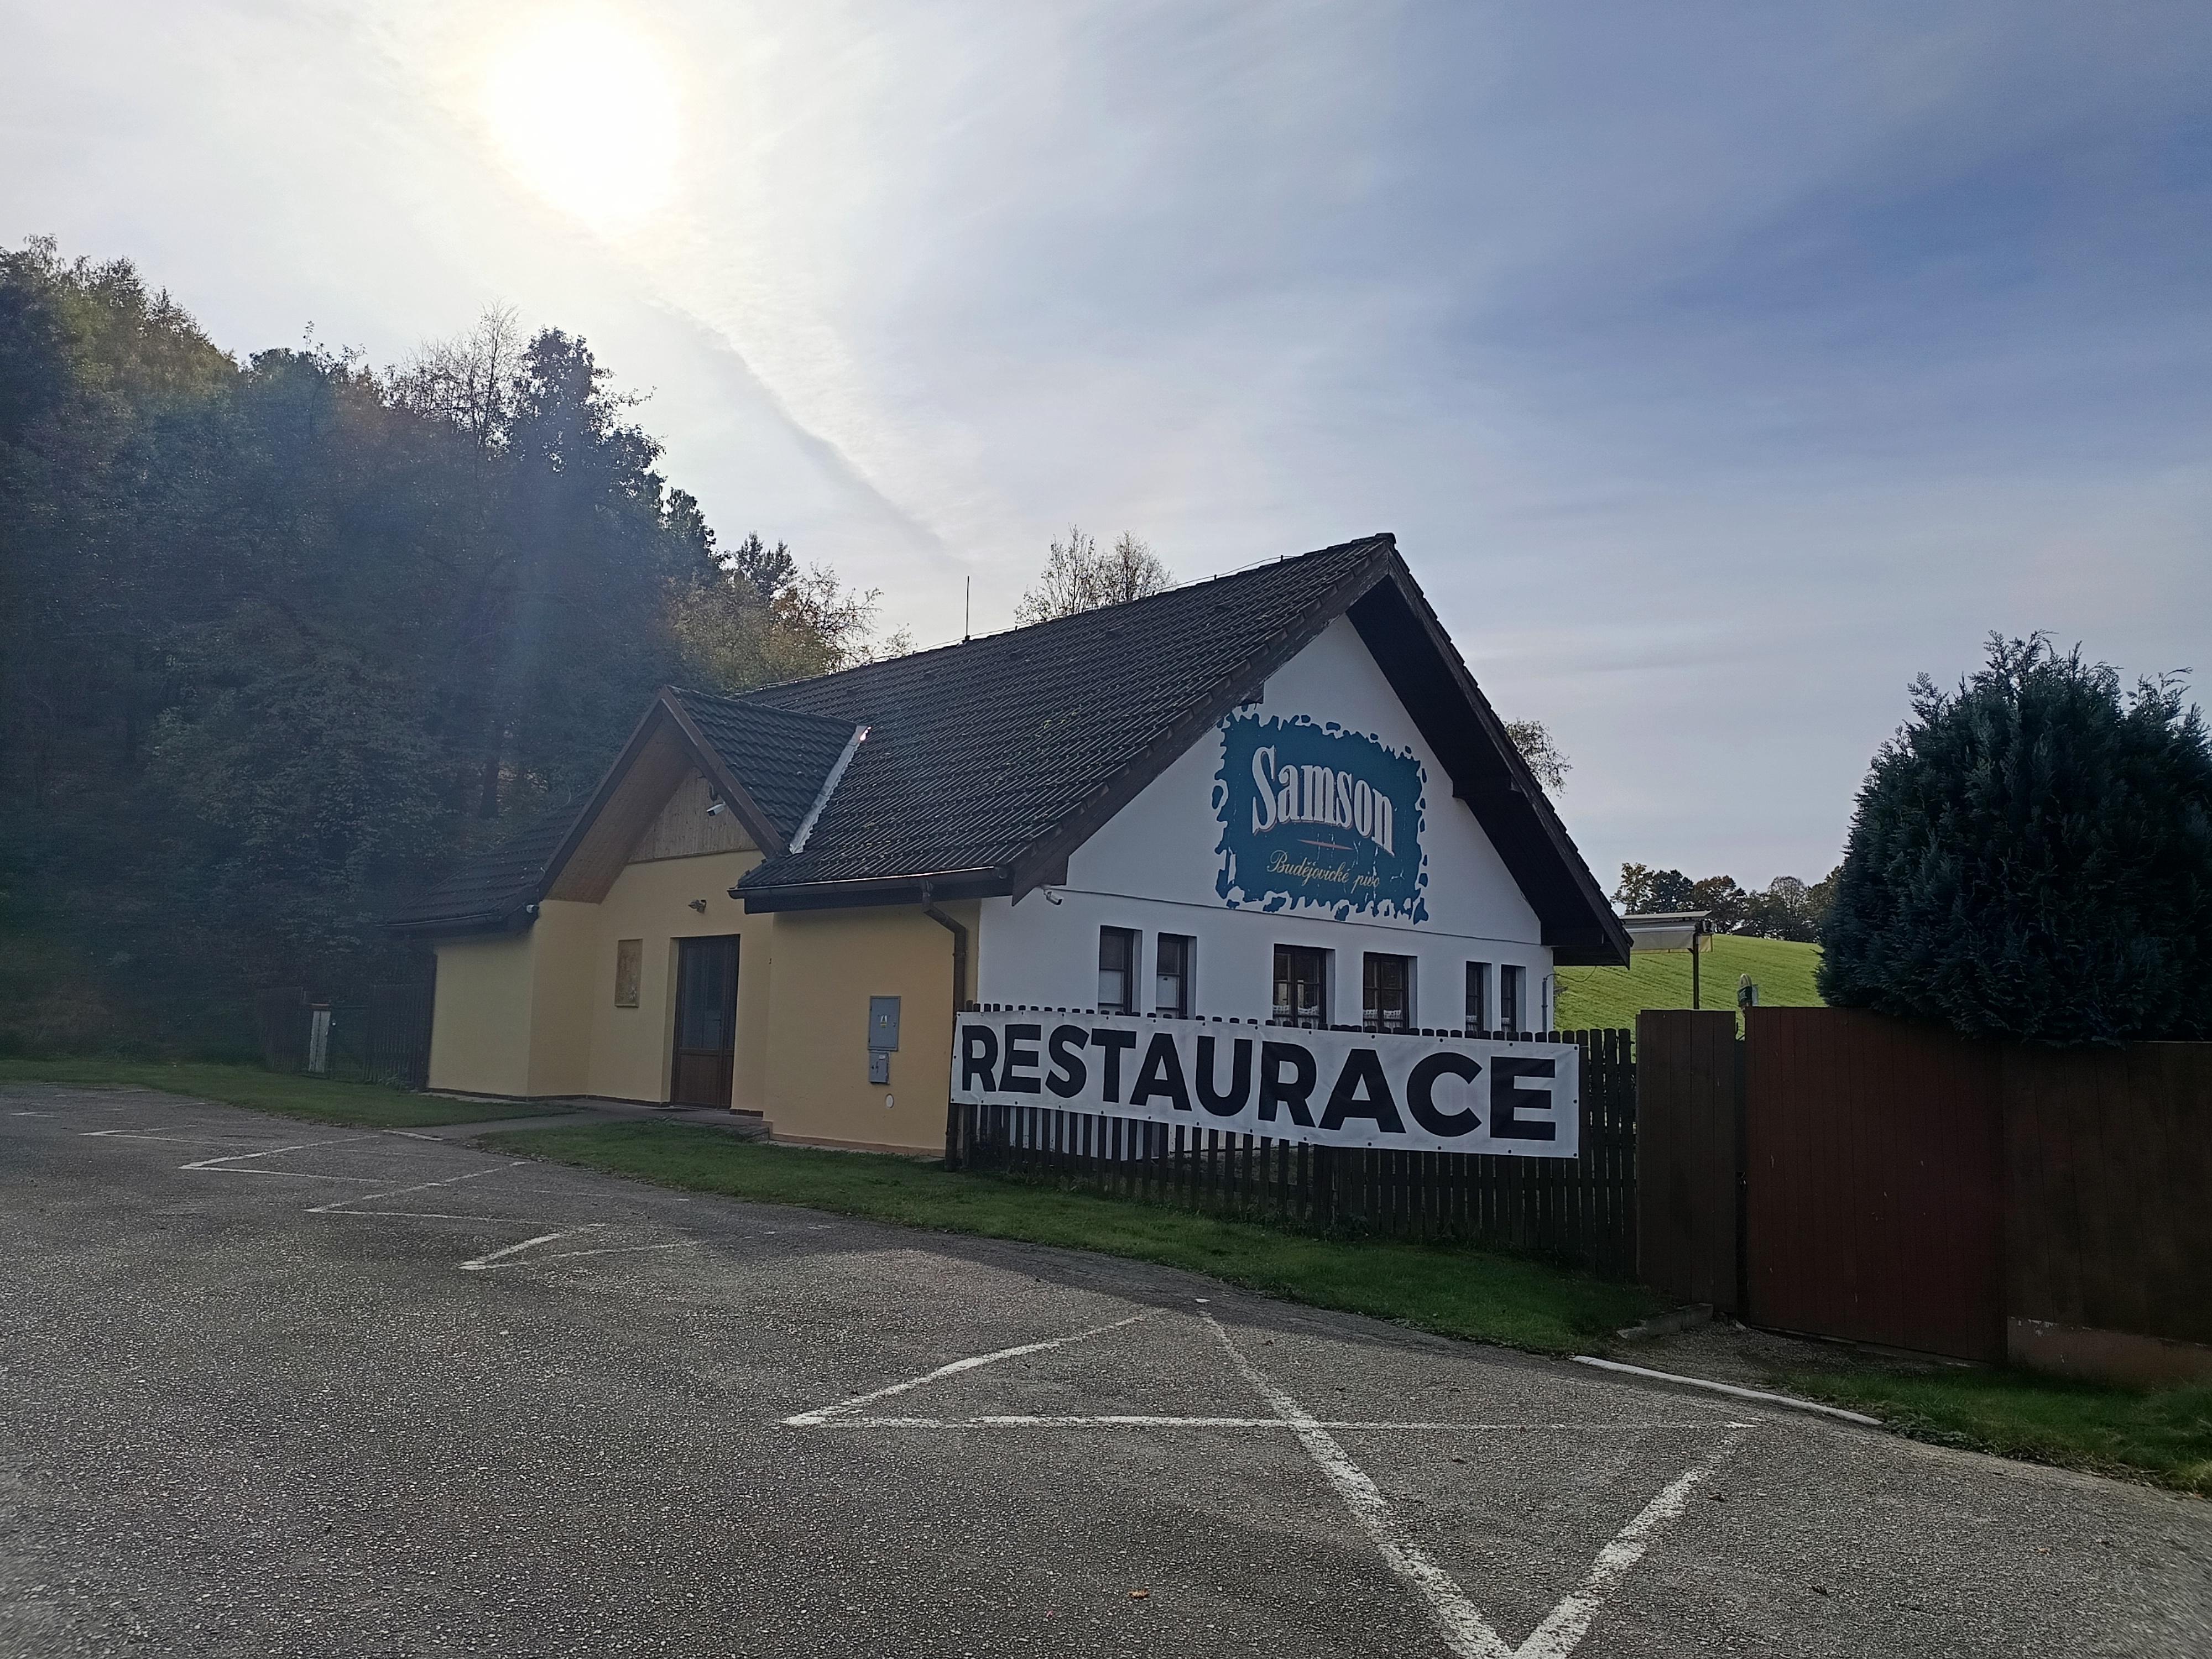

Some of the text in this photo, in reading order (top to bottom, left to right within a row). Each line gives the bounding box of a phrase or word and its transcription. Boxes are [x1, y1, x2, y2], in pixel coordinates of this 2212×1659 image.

[1252, 745, 1395, 857] Samson
[1267, 850, 1380, 894] Budějovické pivo
[962, 1024, 1556, 1141] RESTAURACE
